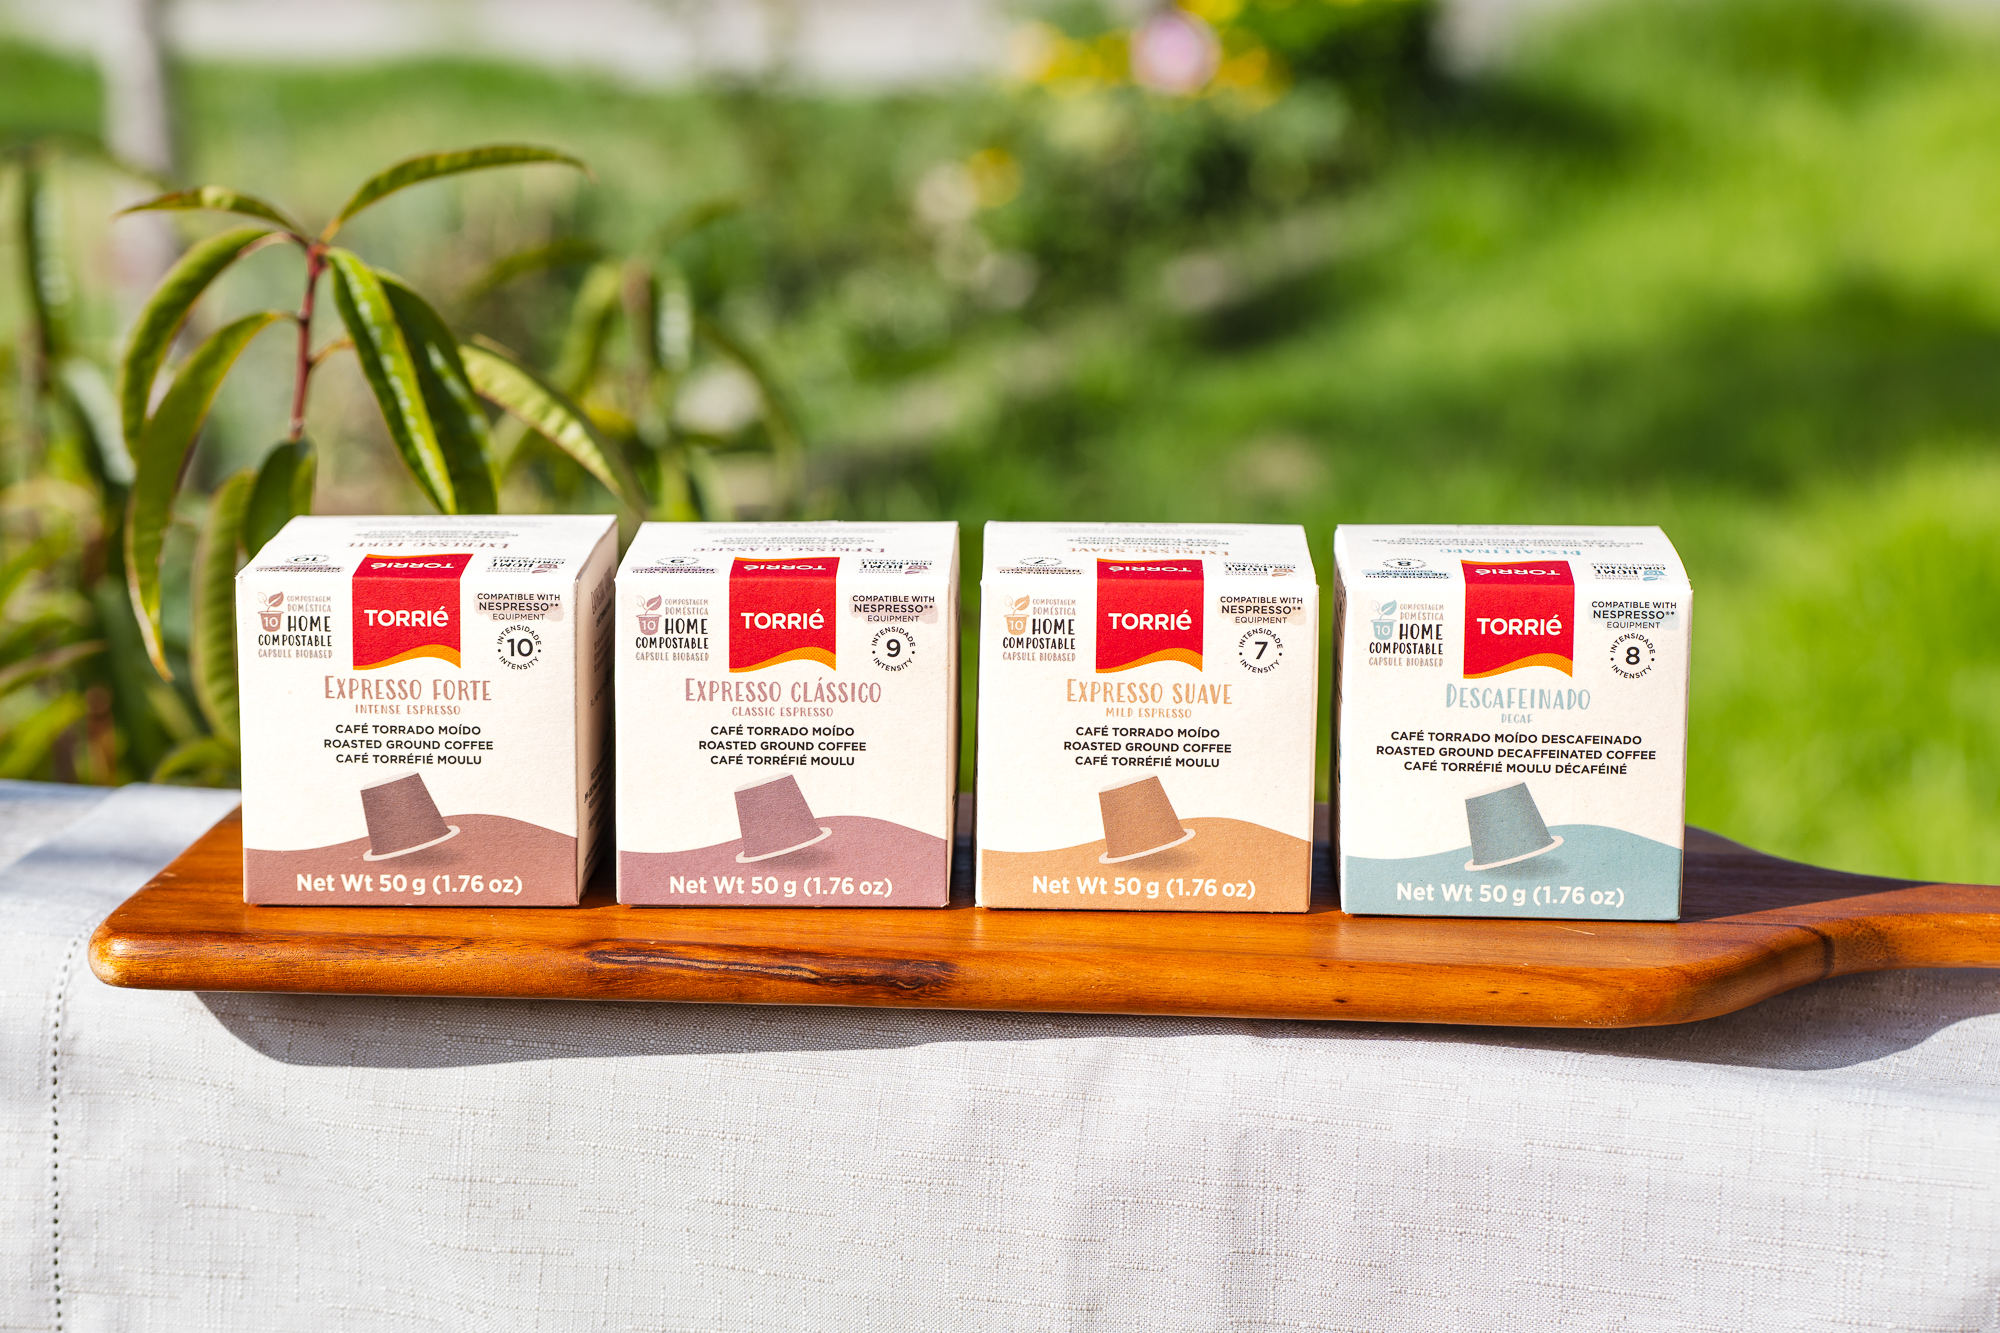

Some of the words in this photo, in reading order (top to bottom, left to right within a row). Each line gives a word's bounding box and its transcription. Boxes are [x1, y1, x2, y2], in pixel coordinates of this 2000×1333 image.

[852, 595, 909, 603] COMPATIBLE
[1220, 596, 1277, 604] COMPATIBLE
[1592, 601, 1650, 609] COMPATIBLE
[263, 617, 278, 628] 10
[287, 616, 331, 632] HOME
[642, 620, 656, 631] 10
[867, 615, 920, 623] EQUIPMENT
[1010, 620, 1024, 631] 10
[1235, 616, 1288, 624] EQUIPMENT
[664, 618, 709, 635] HOME
[1032, 618, 1076, 635] HOME
[1376, 625, 1391, 636] 10
[1399, 623, 1443, 641] HOME
[258, 634, 332, 647] COMPOSTABLE
[497, 624, 542, 645] INTENSIDADE
[871, 626, 916, 647] INTENSIDADE
[1238, 628, 1284, 649] INTENSIDADE
[507, 638, 534, 657] 10
[636, 637, 709, 649] COMPOSTABLE
[886, 639, 901, 658] 9
[1003, 637, 1076, 650] COMPOSTABLE
[1369, 642, 1444, 655] COMPOSTABLE
[1609, 633, 1656, 654] INTENSIDADE
[258, 649, 292, 658] CAPSULE
[296, 649, 333, 659] BIOBASED
[636, 651, 670, 661] CAPSULE
[672, 652, 709, 662] BIOBASED
[1002, 652, 1036, 661] CAPSULE
[1039, 652, 1076, 662] BIOBASED
[1255, 641, 1268, 660] 7
[1625, 646, 1641, 666] 8
[499, 655, 539, 670] INTENSITY
[873, 657, 913, 672] INTENSITY
[1240, 659, 1280, 674] INTENSITY
[1369, 656, 1403, 666] CAPSULE
[1406, 657, 1444, 667] BIOBASED
[1611, 664, 1652, 679] INTENSITY
[325, 675, 422, 700] EXPRESSO
[433, 679, 492, 701] FORTE
[685, 678, 782, 703] EXPRESSO
[791, 677, 882, 703] CLÁSSICO
[1067, 679, 1163, 704] EXPRESSO
[1172, 683, 1233, 705] SUAVE
[1446, 683, 1591, 710] DESCAFEINADO
[355, 704, 401, 715] INTENSE
[407, 705, 461, 716] ESPRESSO
[732, 706, 775, 717] CLASSIC
[780, 707, 834, 717] ESPRESSO
[1106, 707, 1134, 718] MILD
[1138, 708, 1192, 718] ESPRESSO
[1501, 714, 1533, 724] DECAF
[335, 723, 369, 734] CAFÉ
[372, 725, 434, 735] TORRADO
[438, 724, 481, 735] MOÍDO
[710, 724, 744, 736] CAFÉ
[747, 727, 808, 736] TORRADO
[812, 725, 855, 737] MOÍDO
[1076, 725, 1109, 737] CAFÉ
[1112, 727, 1174, 737] TORRADO
[1178, 727, 1220, 738] MOÍDO
[1391, 730, 1425, 742] CAFÉ
[1428, 732, 1491, 743] TORRADO
[1495, 732, 1538, 744] MOÍDO
[1542, 735, 1642, 745] DESCAFEINADO
[323, 739, 382, 749] ROASTED
[386, 740, 440, 750] GROUND
[444, 741, 494, 750] COFFEE
[699, 741, 757, 750] ROASTED
[760, 742, 814, 751] GROUND
[818, 742, 866, 751] COFFEE
[1063, 741, 1121, 751] ROASTED
[1125, 743, 1179, 753] GROUND
[1183, 743, 1232, 754] COFFEE
[336, 753, 369, 763] CAFÉ
[373, 753, 433, 764] TORRÉFIÉ
[438, 755, 482, 765] MOULU
[1376, 746, 1435, 757] ROASTED
[1439, 748, 1494, 758] GROUND
[1498, 748, 1602, 760] DECAFFEINATED
[1606, 750, 1656, 760] COFFEE
[710, 754, 743, 765] CAFÉ
[747, 754, 807, 765] TORRÉFIÉ
[811, 757, 855, 766] MOULU
[1075, 755, 1108, 766] CAFÉ
[1111, 755, 1172, 767] TORRÉFIÉ
[1176, 758, 1220, 768] MOULU
[1404, 760, 1438, 772] CAFÉ
[1441, 760, 1503, 773] TORRÉFIÉ
[1506, 763, 1551, 774] MOULU
[1555, 762, 1628, 775] DÉCAFÉINÉ
[296, 874, 335, 892] Net
[340, 874, 373, 892] Wt
[379, 874, 408, 892] 50
[412, 877, 426, 896] g
[432, 875, 484, 895] (1.76
[488, 876, 523, 896] oz)
[669, 876, 707, 894] Net
[713, 876, 745, 895] Wt
[751, 877, 779, 895] 50
[783, 879, 797, 898] g
[803, 877, 855, 897] (1.76
[859, 878, 893, 898] oz)
[1032, 876, 1070, 894] Net
[1076, 876, 1107, 895] Wt
[1113, 877, 1141, 896] 50
[1146, 880, 1160, 899] g
[1166, 878, 1217, 899] (1.76
[1222, 880, 1256, 900] oz)
[1397, 882, 1435, 901] Net
[1441, 883, 1473, 902] Wt
[1479, 885, 1508, 903] 50
[1512, 888, 1526, 906] g
[1533, 885, 1585, 906] (1.76
[1590, 888, 1625, 908] oz)
